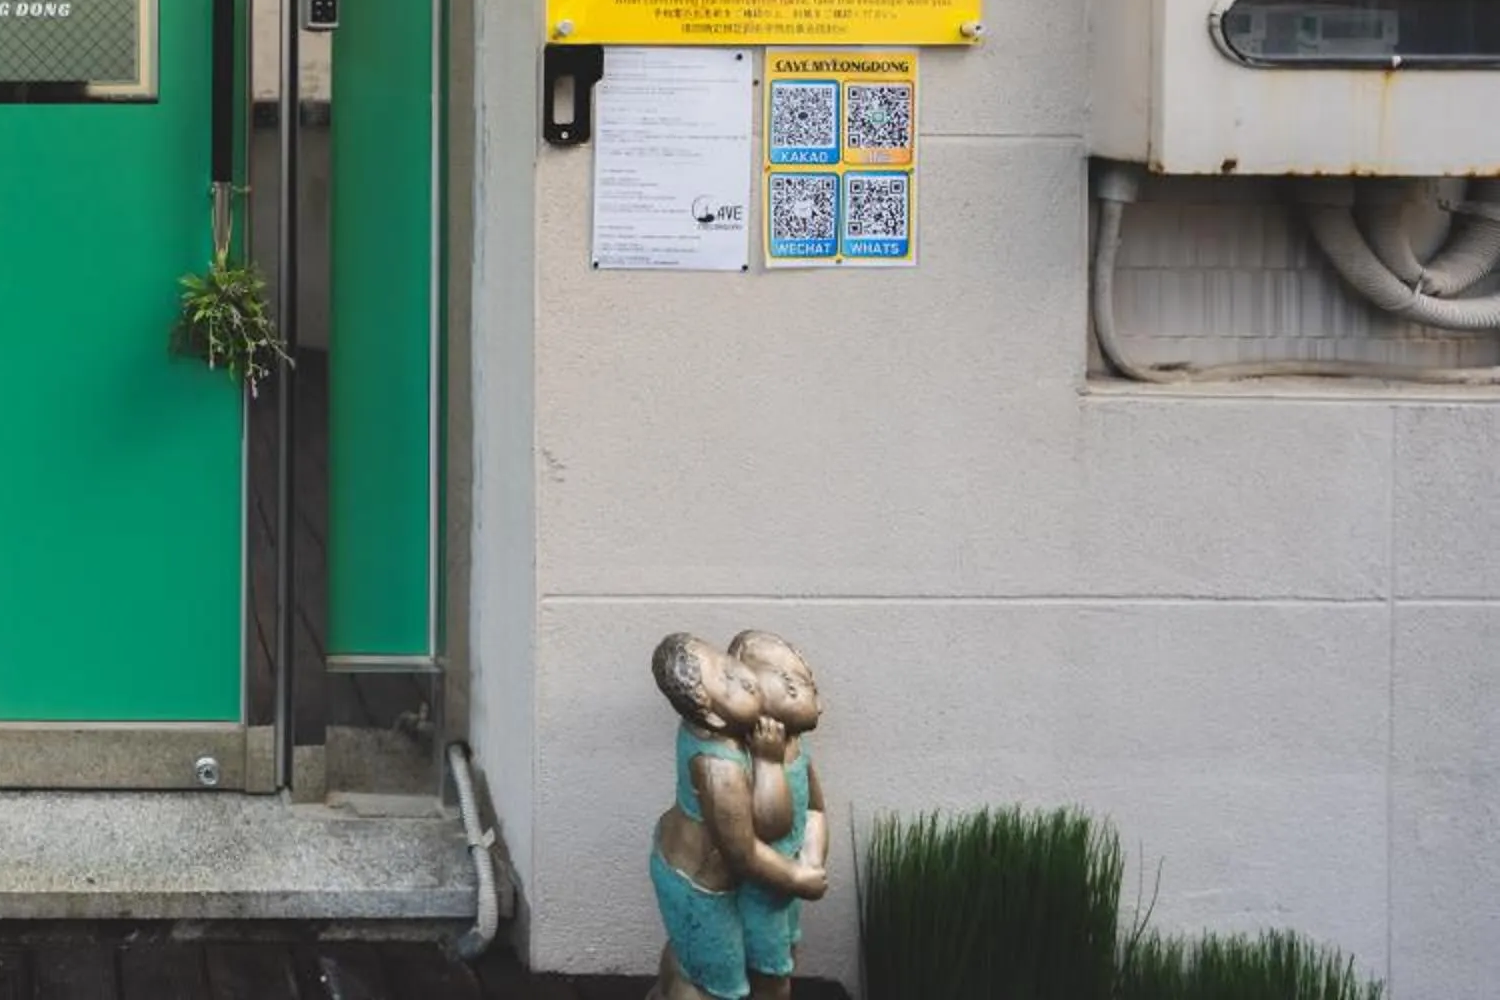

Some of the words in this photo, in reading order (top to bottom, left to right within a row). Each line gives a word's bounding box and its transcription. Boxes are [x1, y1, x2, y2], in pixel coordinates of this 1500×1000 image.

[15, 2, 72, 17] DONG
[780, 151, 829, 163] KAKAO
[775, 243, 832, 255] WECHAT
[850, 243, 900, 255] WHATS
